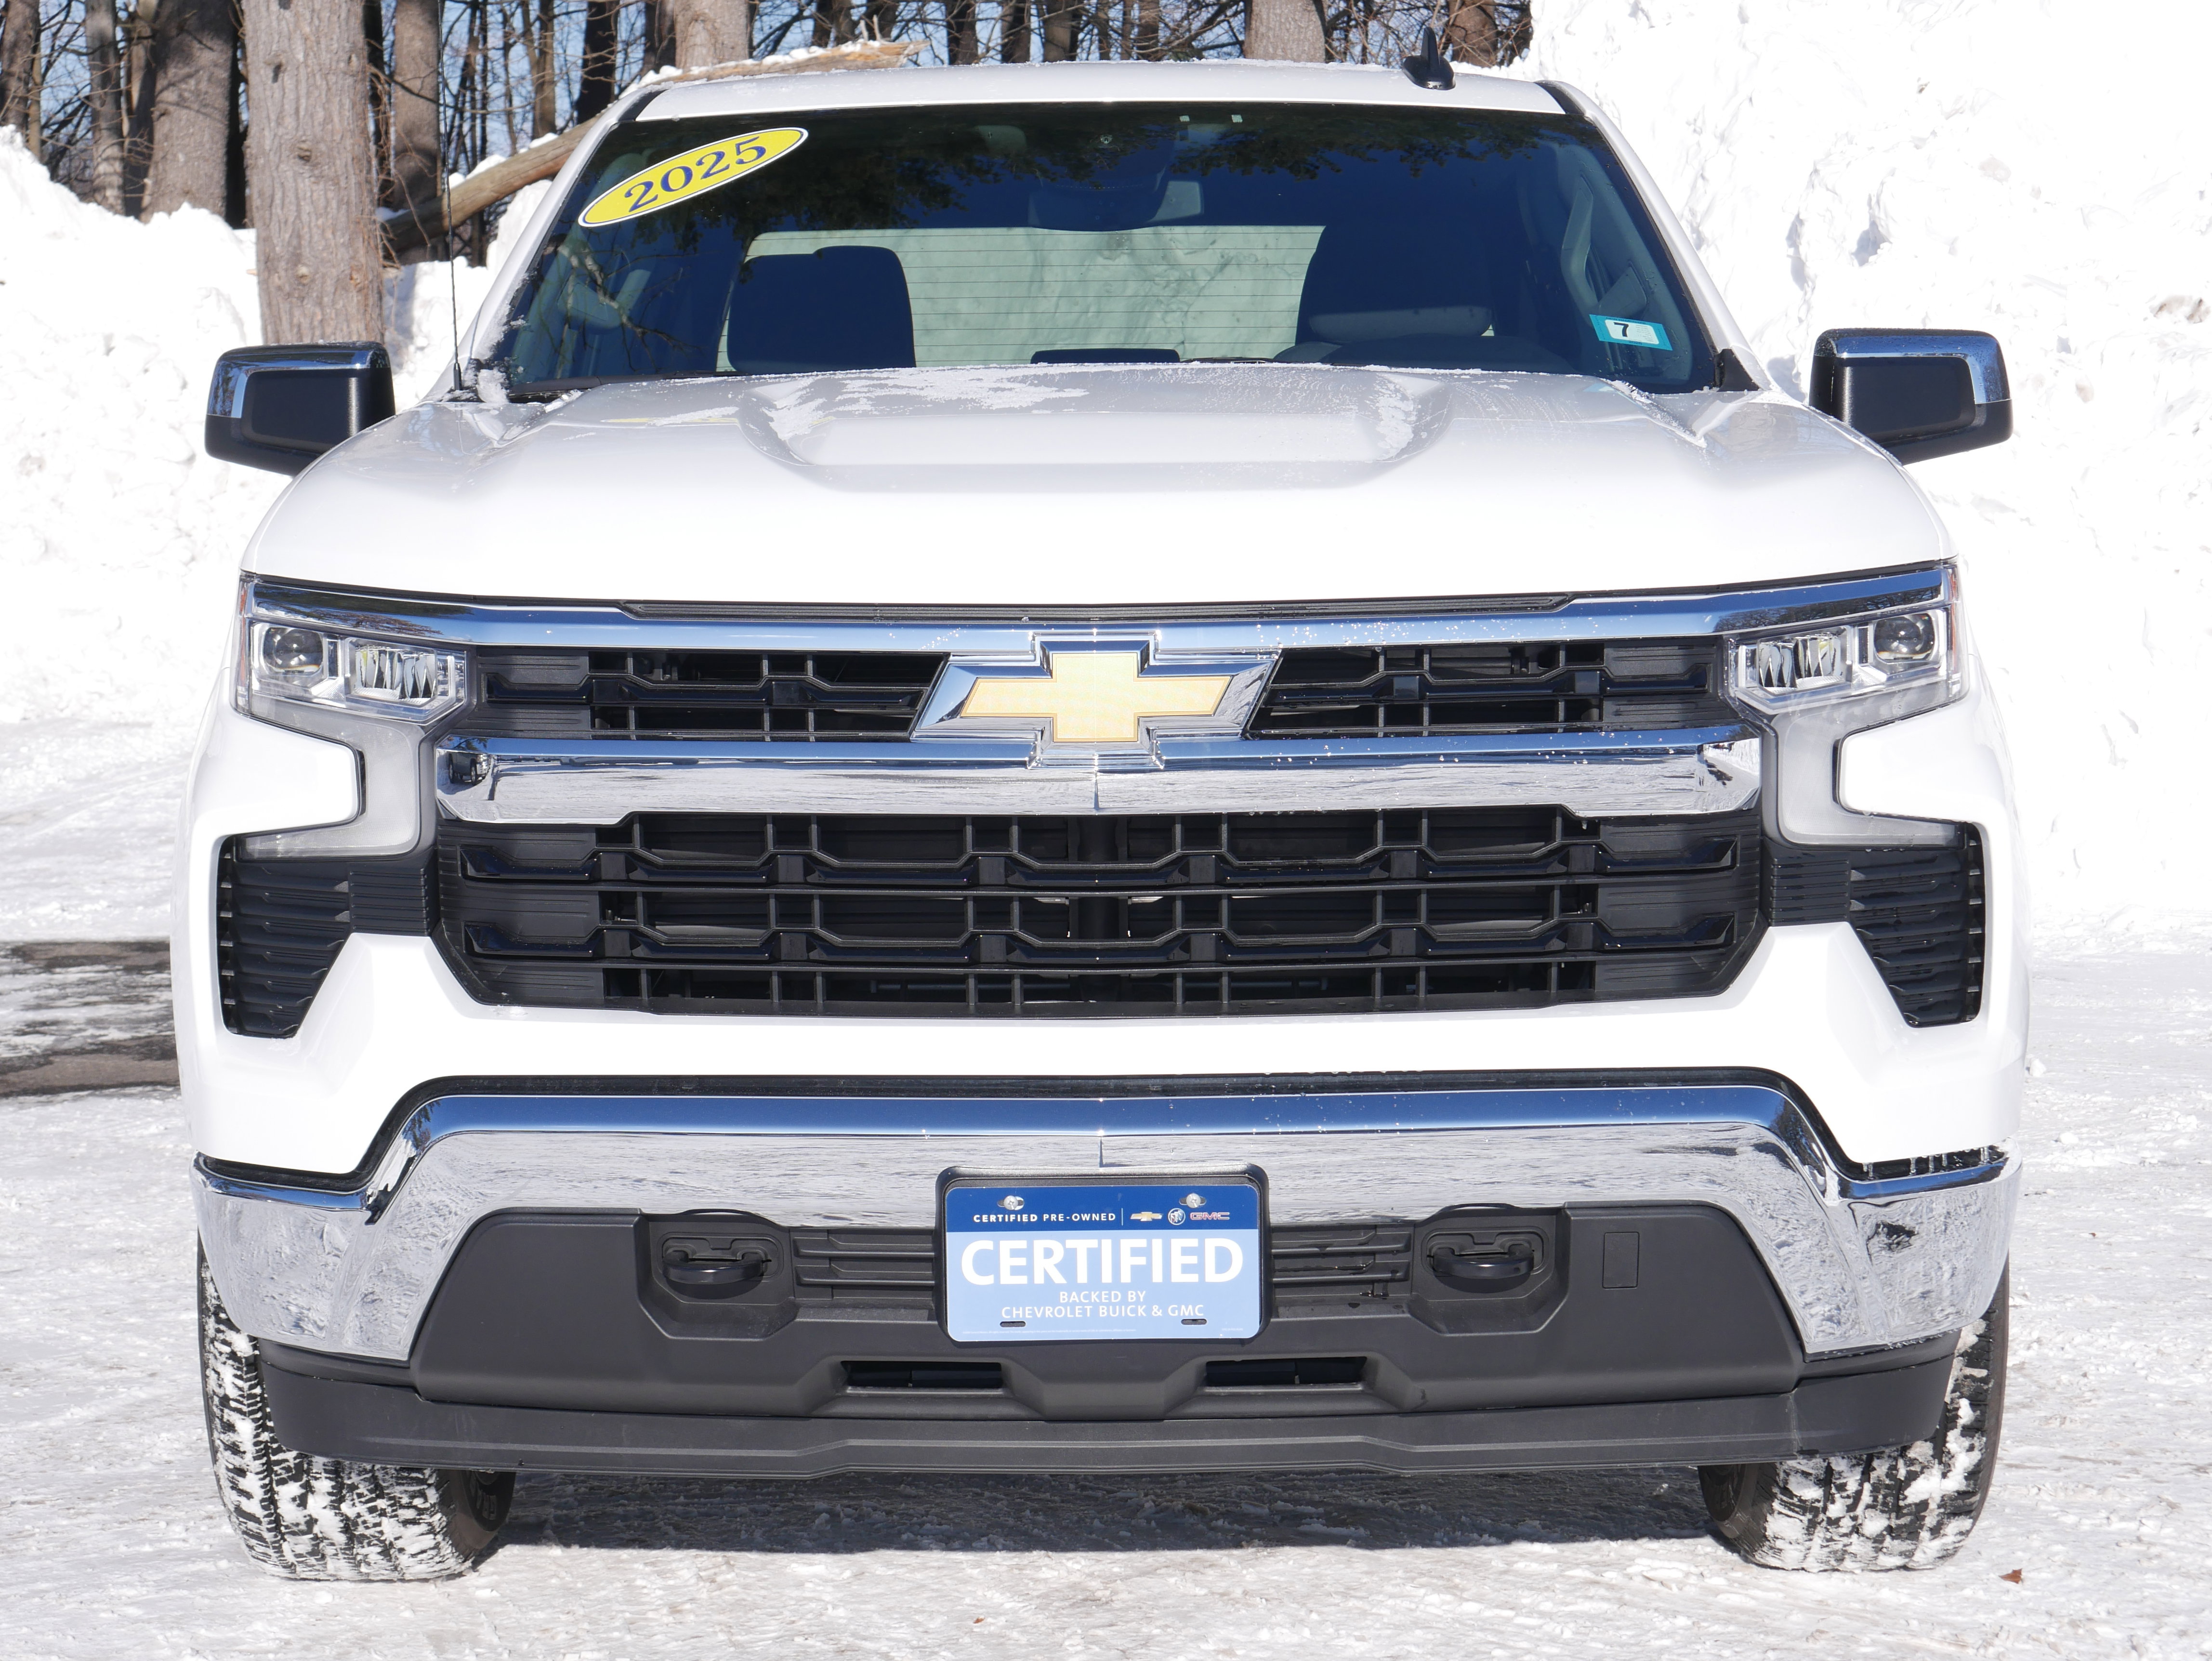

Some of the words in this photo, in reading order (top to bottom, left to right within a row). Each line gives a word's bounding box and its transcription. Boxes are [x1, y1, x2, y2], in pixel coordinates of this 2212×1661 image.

[624, 136, 766, 212] 2025
[1613, 322, 1629, 338] 7
[973, 1214, 1038, 1223] CERTIFIED
[1043, 1213, 1116, 1221] PRE-OWNED
[1190, 1212, 1230, 1221] GMC
[961, 1238, 1243, 1285] CERTIFIED
[1060, 1291, 1121, 1303] BACKED
[1128, 1291, 1146, 1302] BY
[1001, 1305, 1093, 1318] CHEVROLET
[1099, 1305, 1146, 1317] BUICK
[1152, 1305, 1162, 1317] &
[1168, 1305, 1203, 1316] GMC
